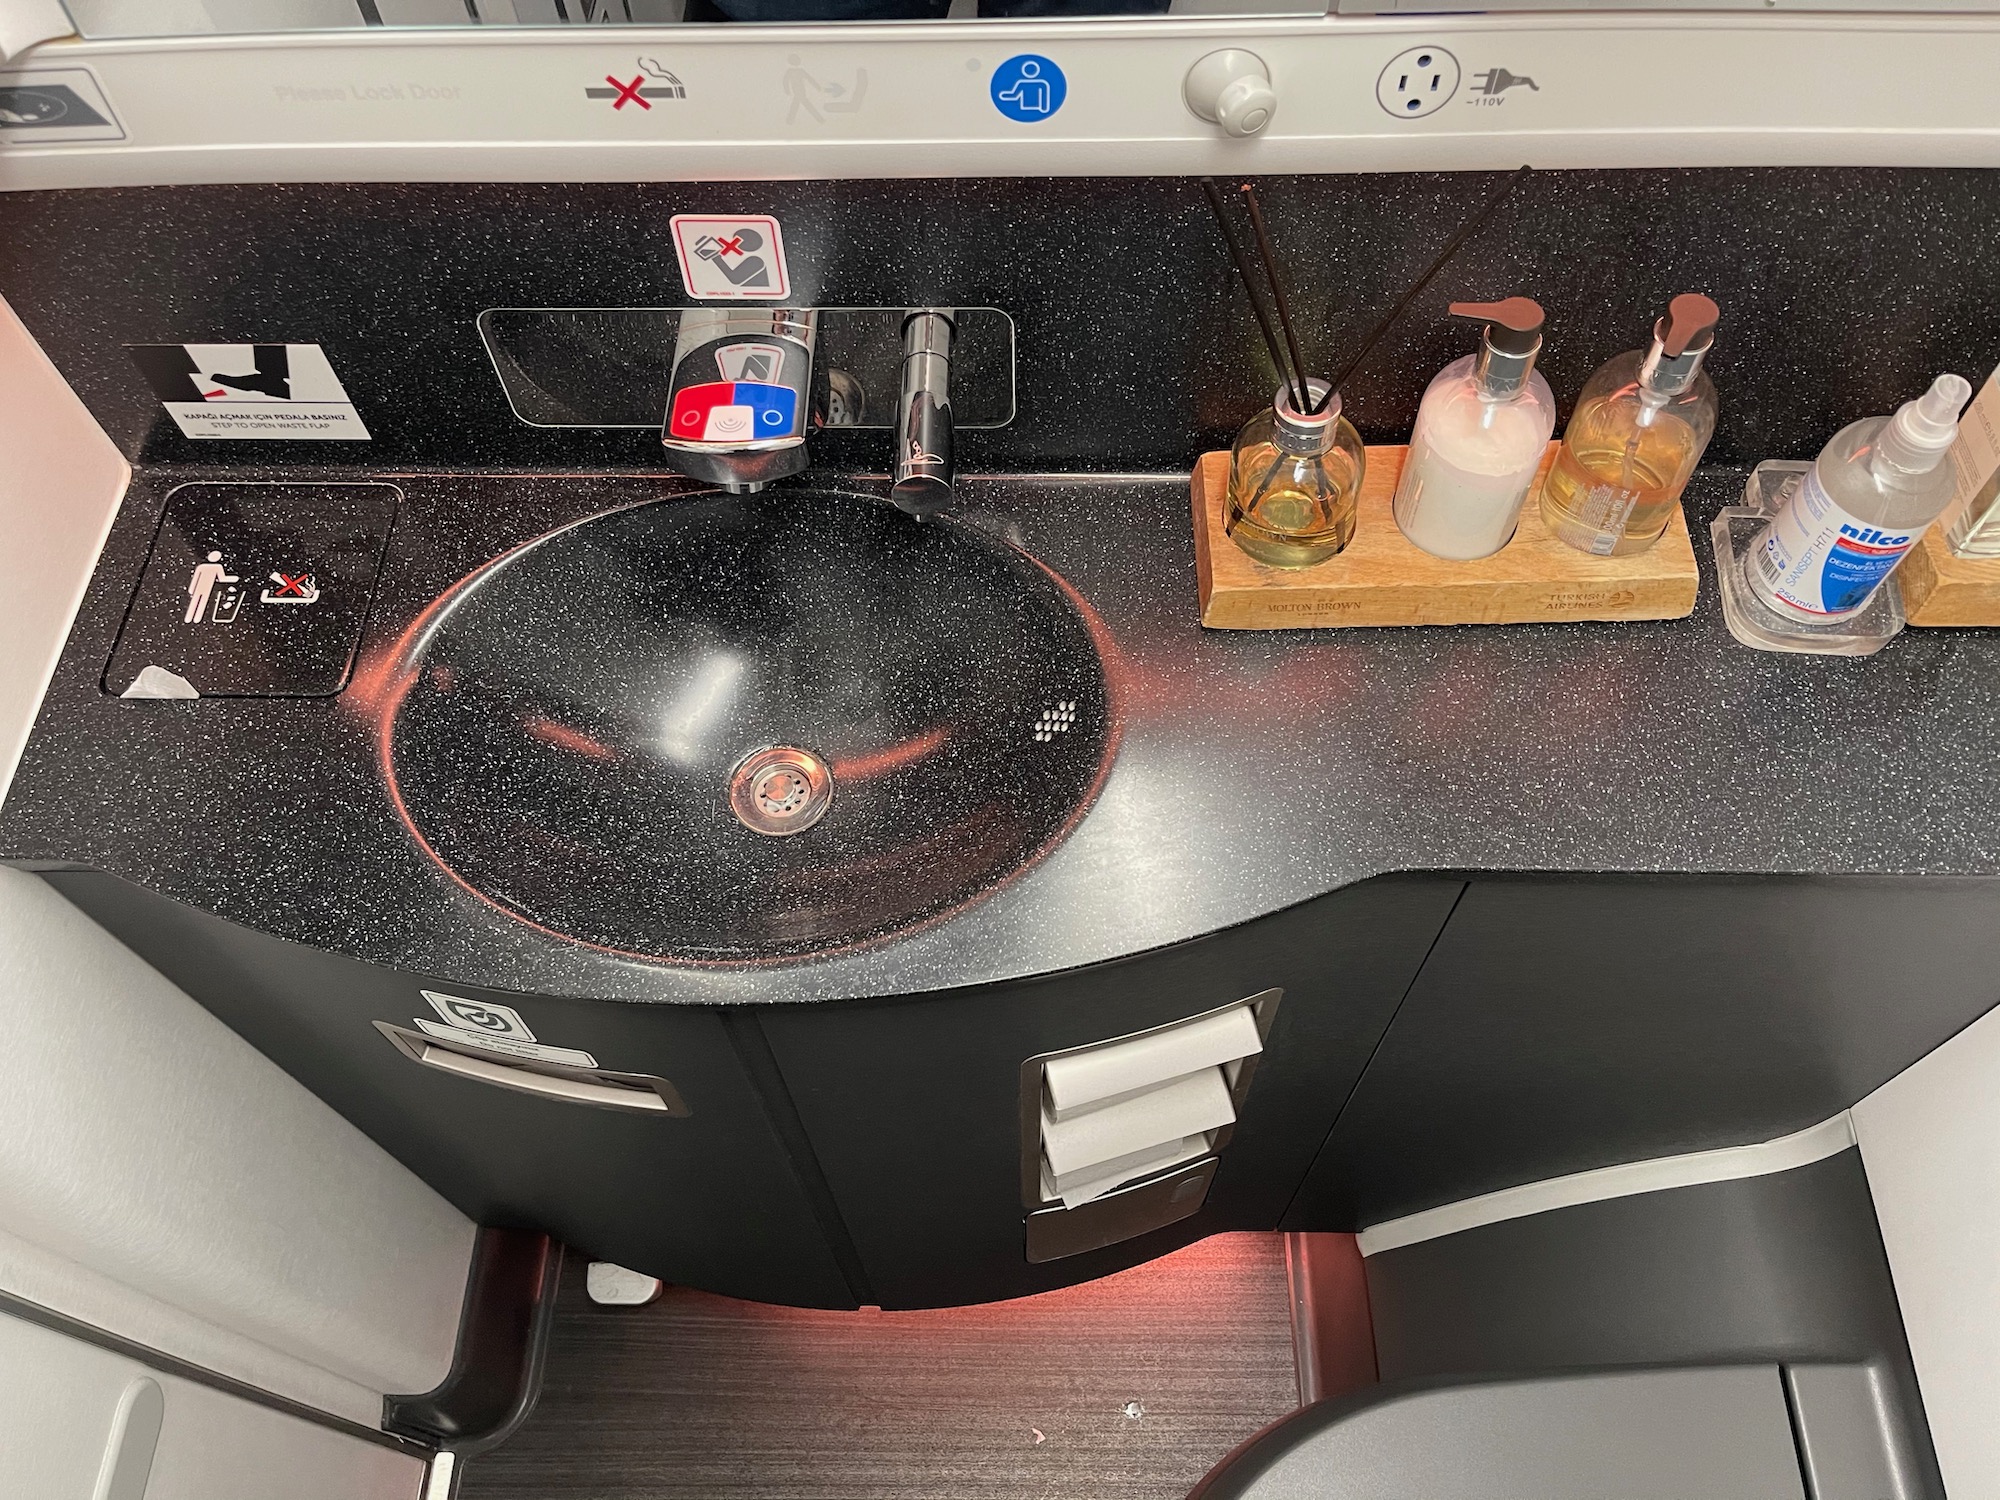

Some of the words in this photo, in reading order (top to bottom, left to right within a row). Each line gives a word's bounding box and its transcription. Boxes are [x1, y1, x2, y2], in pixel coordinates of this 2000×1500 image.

[350, 83, 405, 101] Lock
[407, 83, 461, 100] Door
[1839, 523, 1910, 546] nilco
[1785, 546, 1818, 587] SANISEPT
[1812, 527, 1835, 550] H711
[1550, 593, 1605, 602] TURKISH
[1777, 587, 1796, 602] 250
[1268, 603, 1312, 613] MOLTON
[1317, 601, 1361, 611] BROWN
[1545, 602, 1603, 610] AIRLINES
